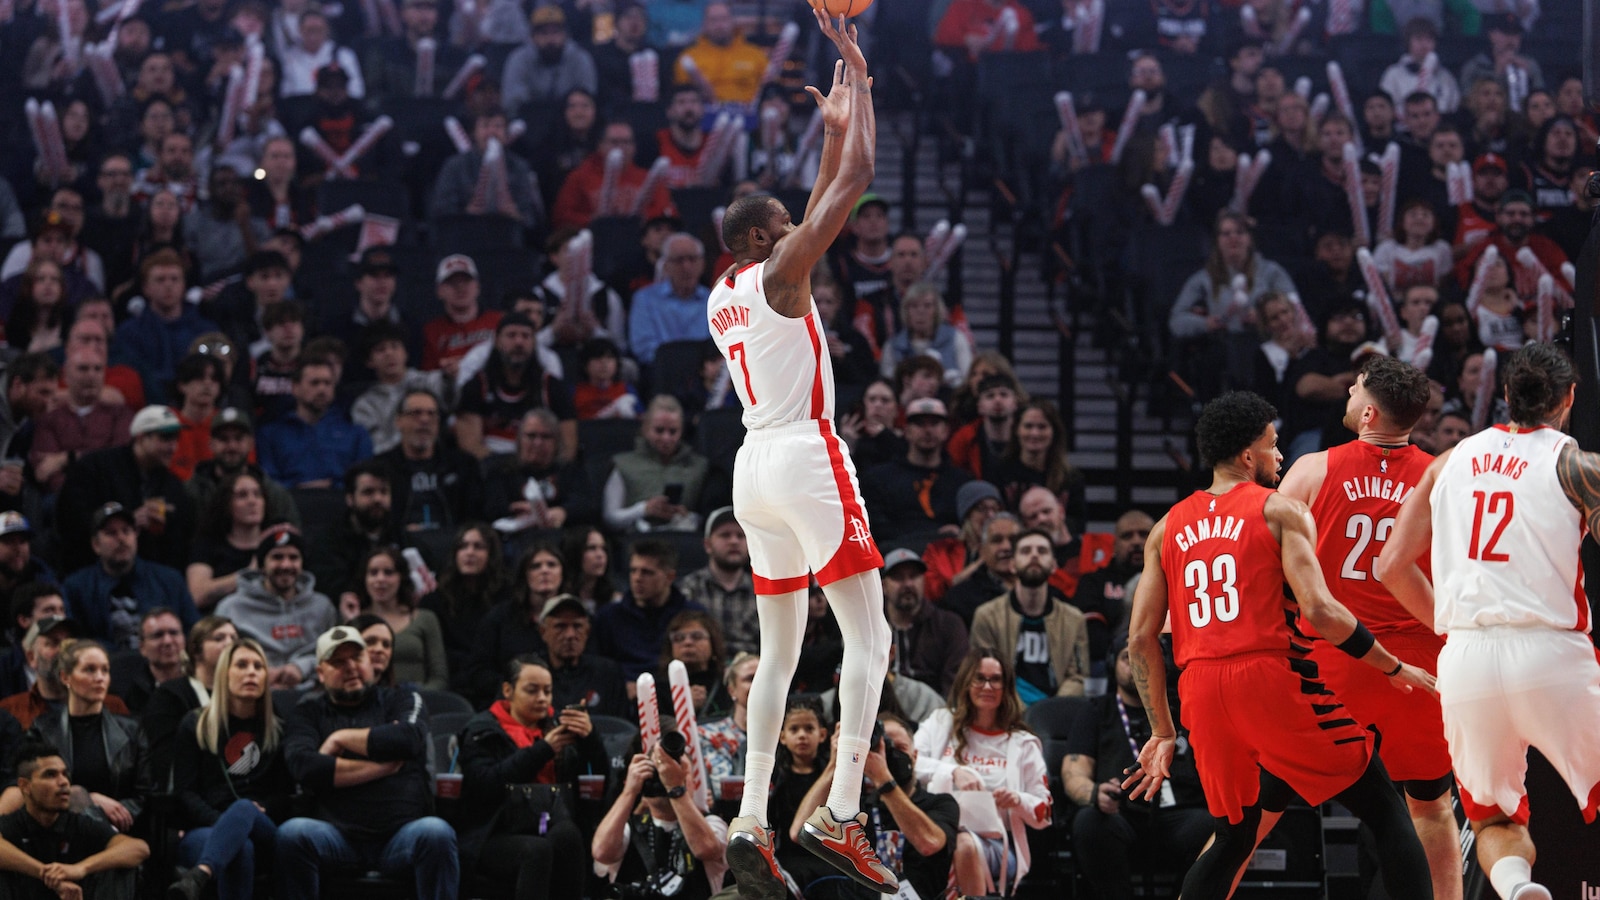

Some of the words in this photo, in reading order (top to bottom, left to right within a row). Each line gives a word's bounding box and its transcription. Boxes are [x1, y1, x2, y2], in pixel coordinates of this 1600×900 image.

[711, 305, 751, 336] DURANT
[728, 341, 757, 407] 7
[1471, 453, 1529, 481] ADAMS
[1174, 515, 1246, 552] CAMARA
[1468, 490, 1514, 562] 12
[1183, 552, 1241, 629] 33
